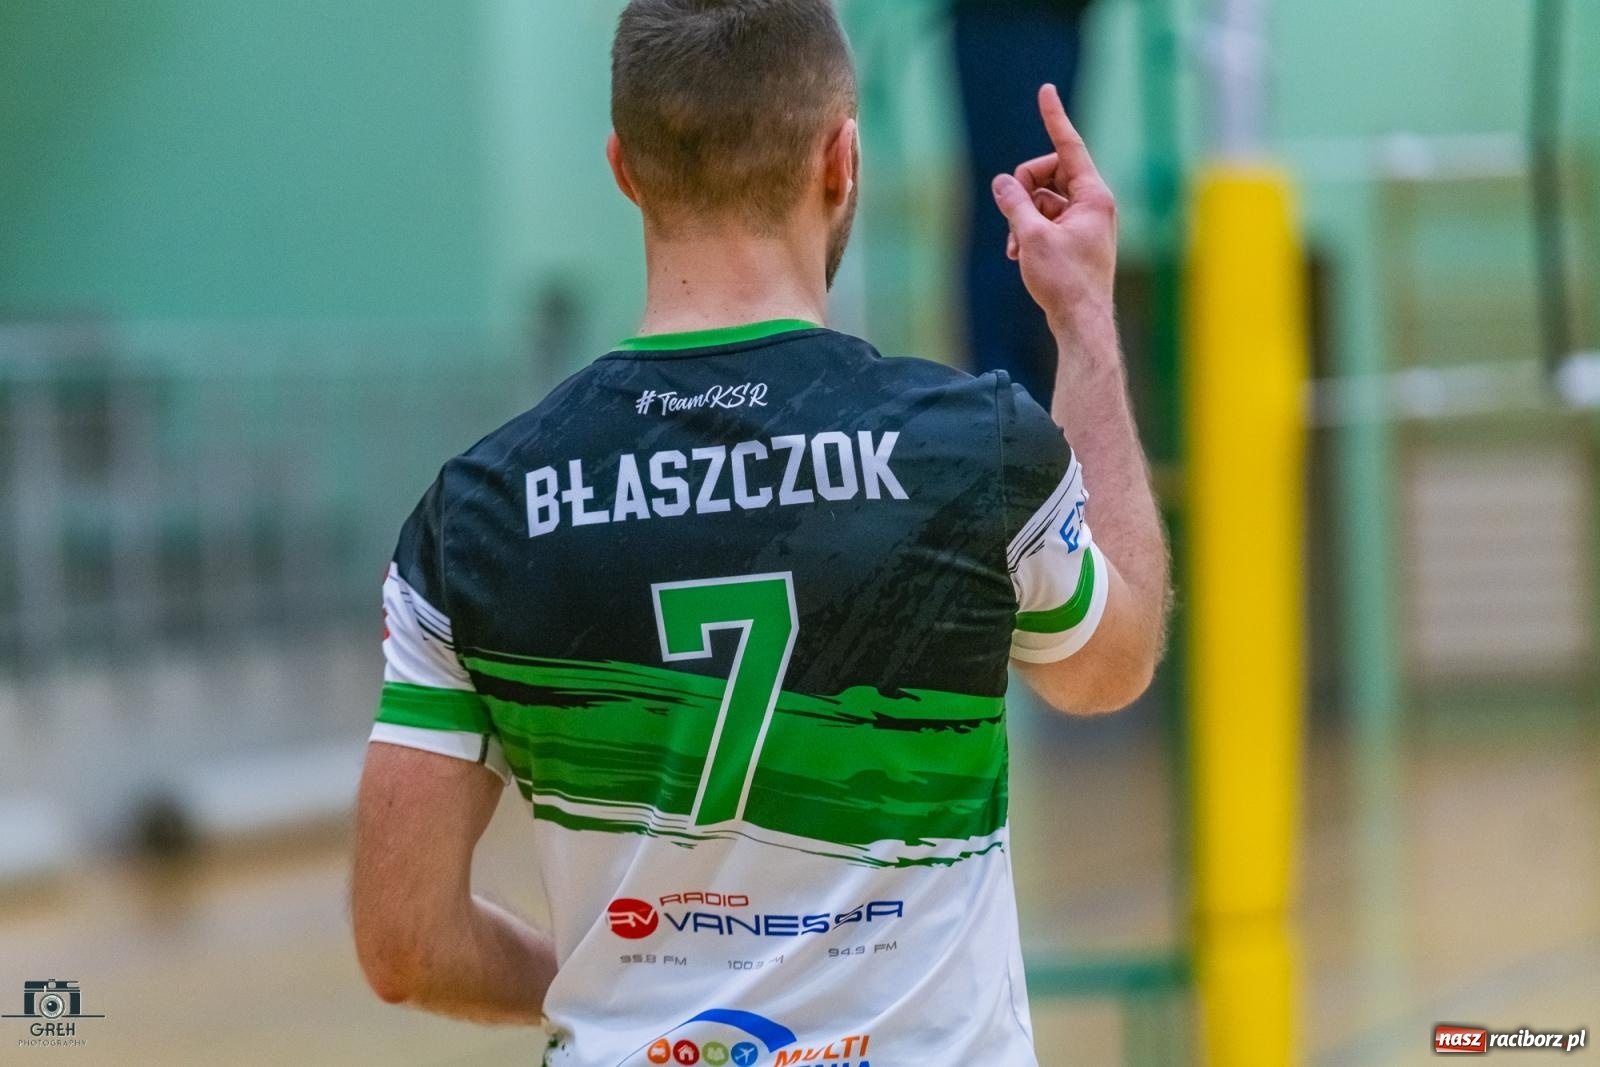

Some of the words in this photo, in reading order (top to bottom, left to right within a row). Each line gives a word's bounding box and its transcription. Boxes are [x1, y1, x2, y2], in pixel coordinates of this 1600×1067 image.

[525, 430, 909, 538] BŁASZCZOK
[651, 571, 799, 827] 7
[659, 892, 749, 907] RADIO
[664, 901, 904, 937] VANESSA
[873, 940, 897, 953] FM
[663, 955, 687, 966] FM
